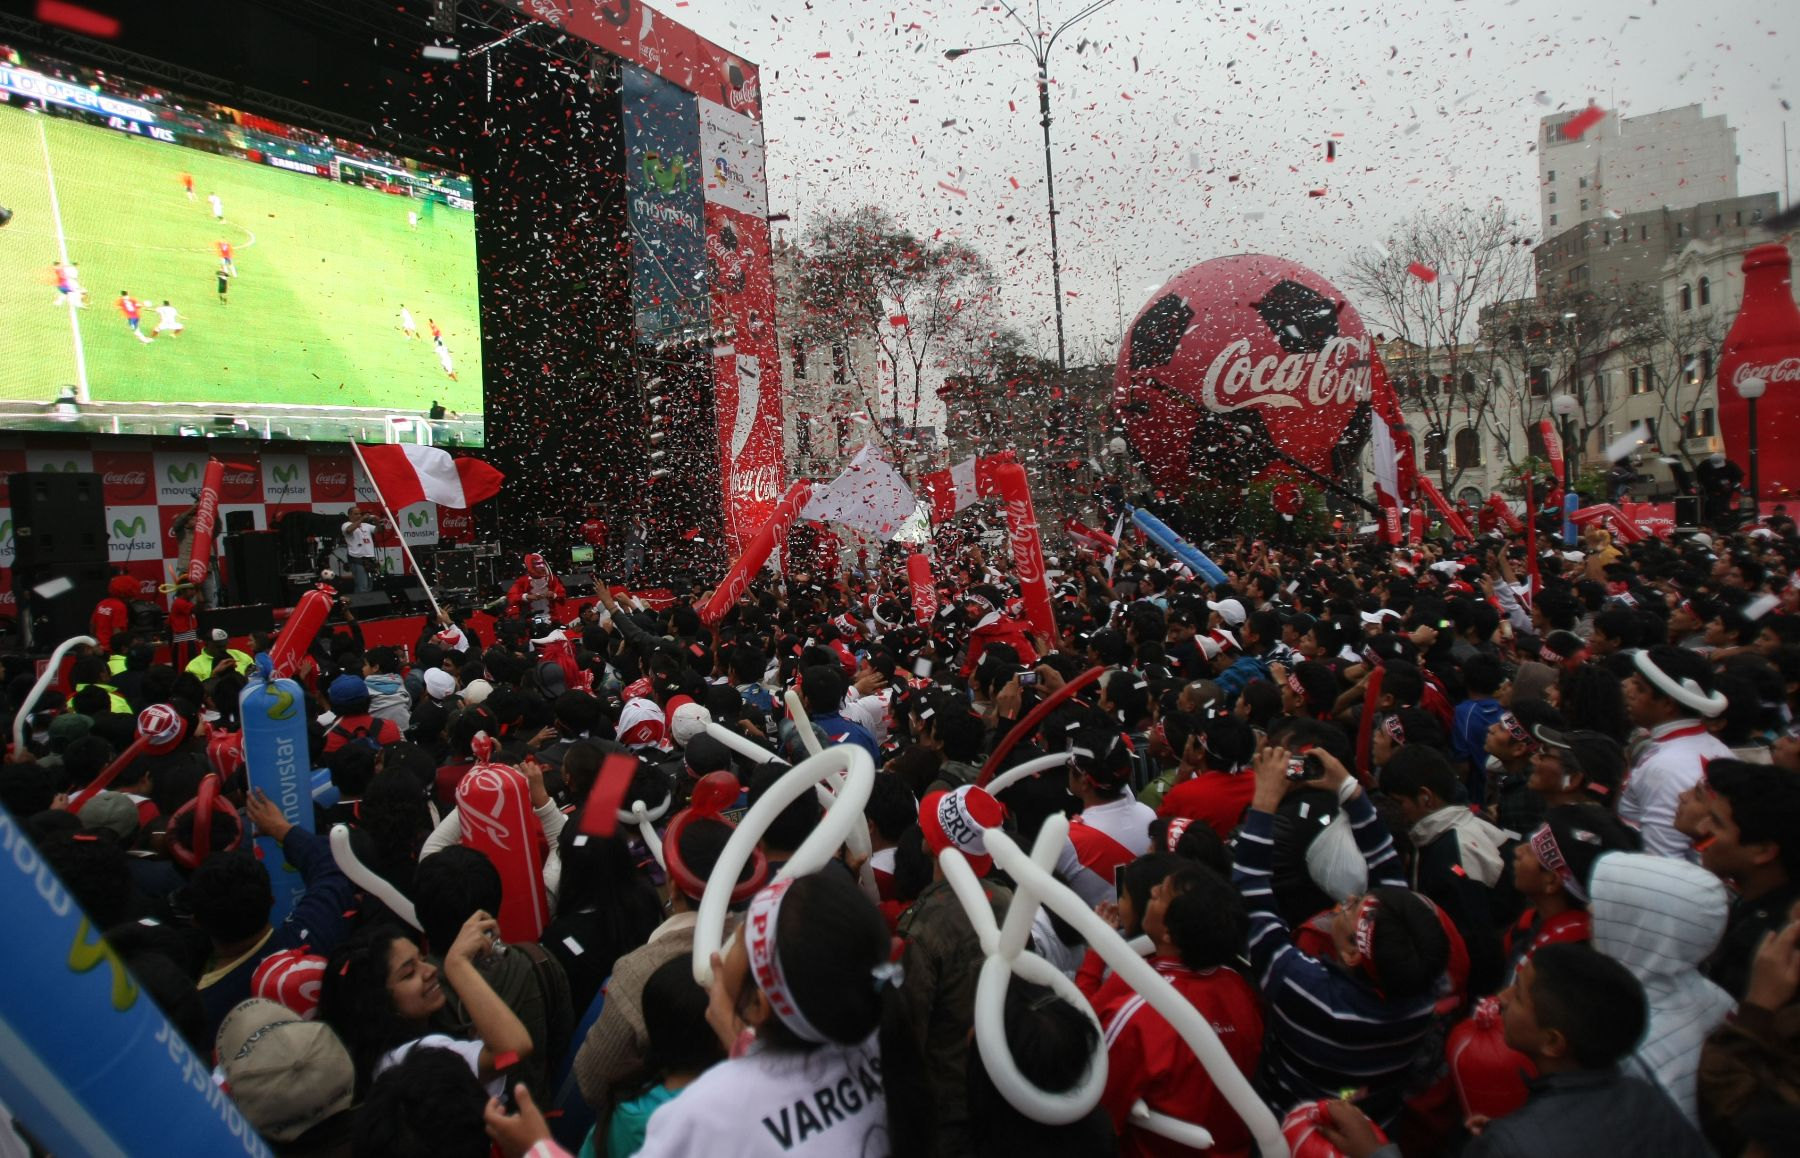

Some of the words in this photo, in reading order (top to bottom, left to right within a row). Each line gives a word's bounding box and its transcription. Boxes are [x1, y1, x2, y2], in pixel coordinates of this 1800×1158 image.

[108, 538, 156, 551] movistar
[403, 530, 436, 538] movistar
[275, 736, 300, 826] movistar
[944, 792, 978, 845] PERU
[751, 911, 795, 1017] PERU
